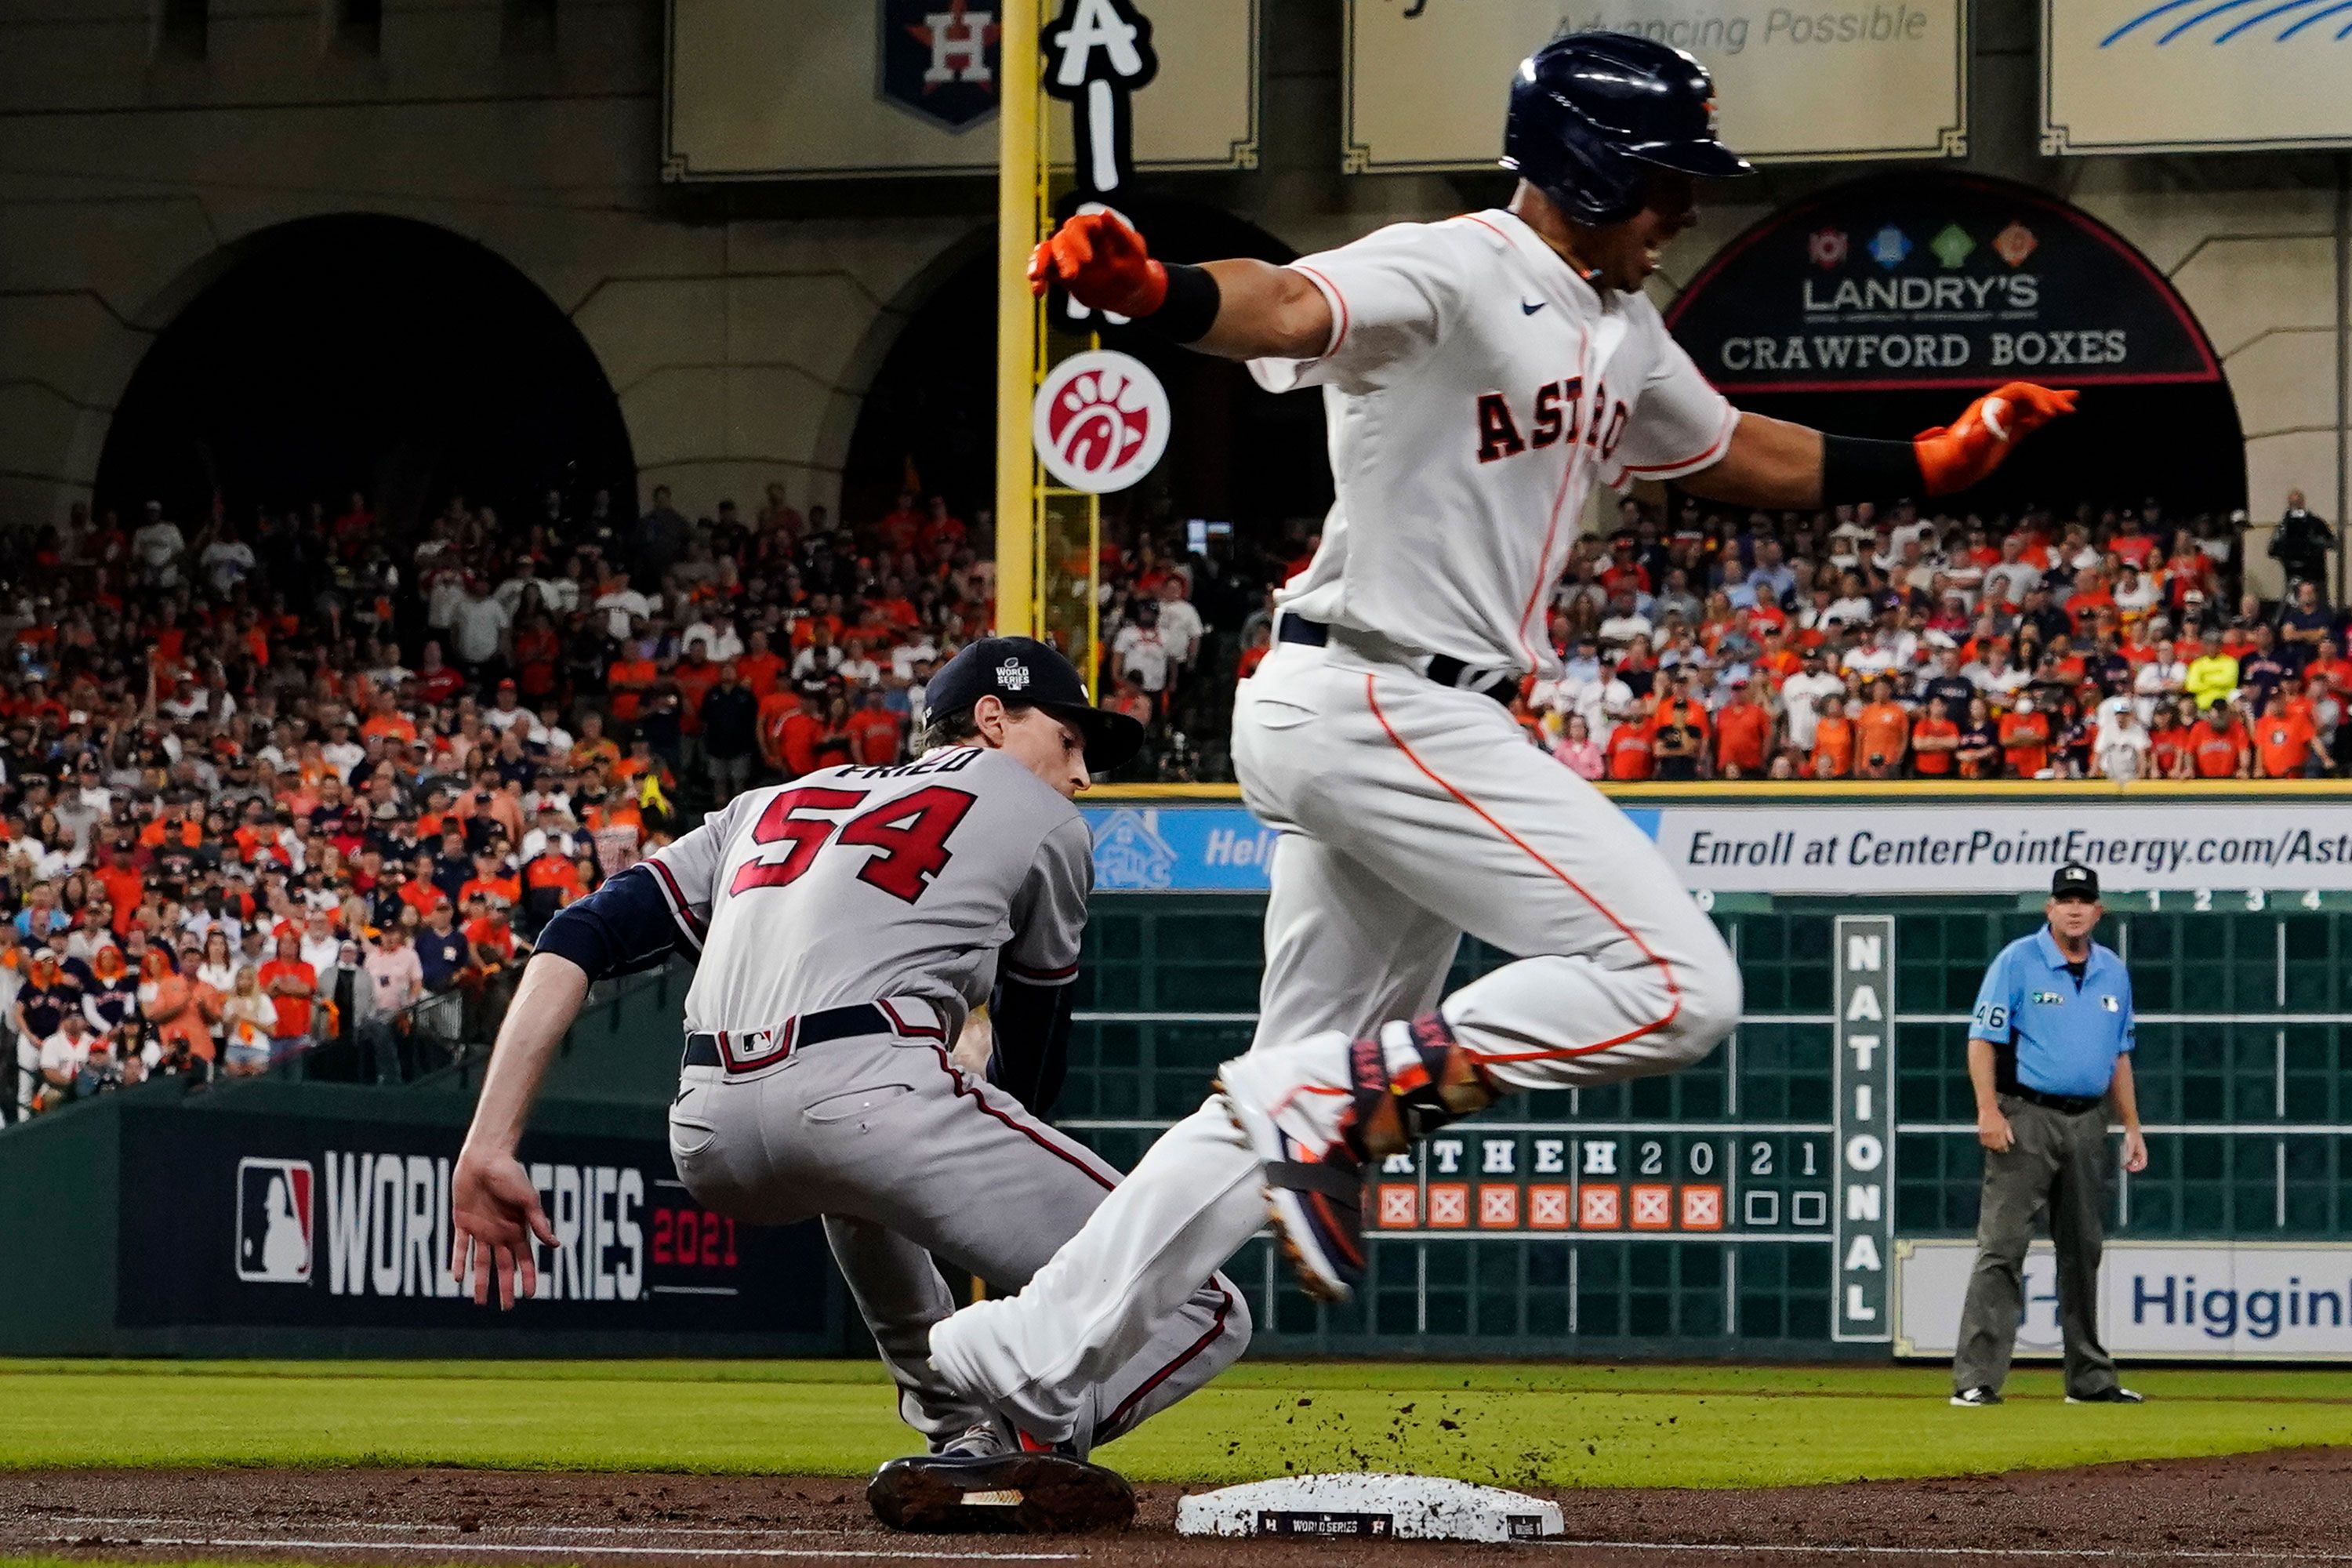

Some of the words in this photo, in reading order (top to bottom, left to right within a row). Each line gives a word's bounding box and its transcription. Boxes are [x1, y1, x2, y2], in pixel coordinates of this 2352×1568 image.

[1551, 11, 1750, 55] Adancing
[1764, 5, 1928, 44] Possible
[1804, 274, 2038, 311] LANDRY'S
[1721, 333, 1971, 370] CRAWFORD
[1989, 329, 2127, 366] BOXES
[996, 666, 1029, 677] WORLD
[997, 676, 1030, 684] SERIES
[729, 785, 978, 906] 54
[1688, 829, 1796, 866] Enroll
[1803, 836, 1840, 865] at
[2148, 888, 2161, 913] 1
[2194, 887, 2212, 912] 2
[2245, 887, 2265, 912] 3
[2301, 887, 2321, 911] 4
[1976, 1004, 2005, 1029] 46
[1845, 934, 1883, 1321] NATIONAL
[514, 1163, 644, 1301] ERIES
[652, 1209, 739, 1266] 2021
[2132, 1275, 2352, 1338] Higgin
[1293, 1519, 1326, 1533] WORLD
[1328, 1521, 1358, 1534] SERIES
